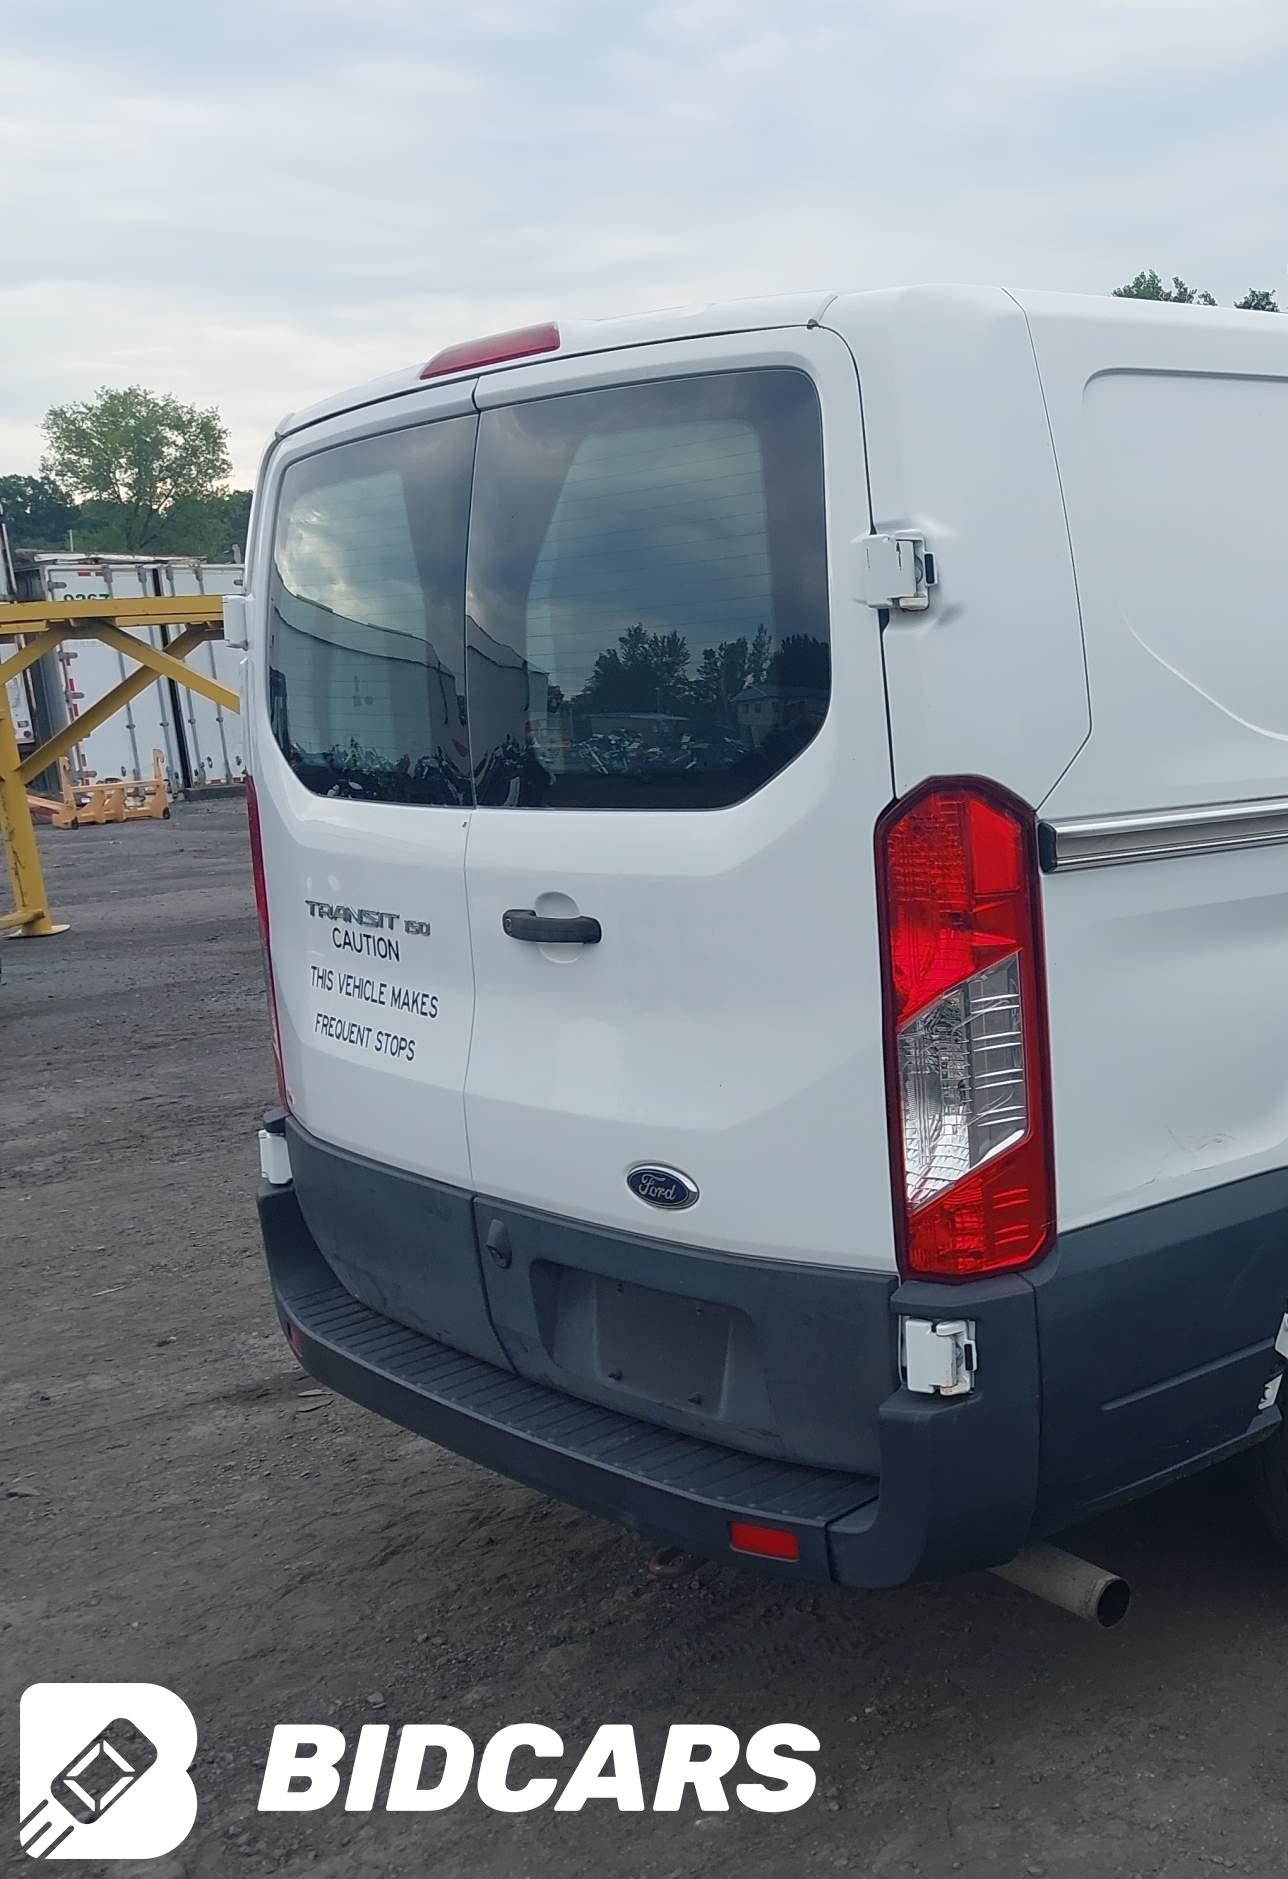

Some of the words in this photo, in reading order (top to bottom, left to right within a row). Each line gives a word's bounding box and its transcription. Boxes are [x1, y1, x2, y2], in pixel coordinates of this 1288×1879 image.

[304, 900, 400, 930] TRANSIT
[332, 927, 400, 962] CAUTION
[311, 966, 334, 991] THIS
[338, 972, 387, 1006] VEHICLE
[391, 986, 439, 1019] MAKES
[314, 1013, 372, 1048] FREQUENT
[375, 1030, 416, 1061] STOPS
[638, 1173, 676, 1200] Ford
